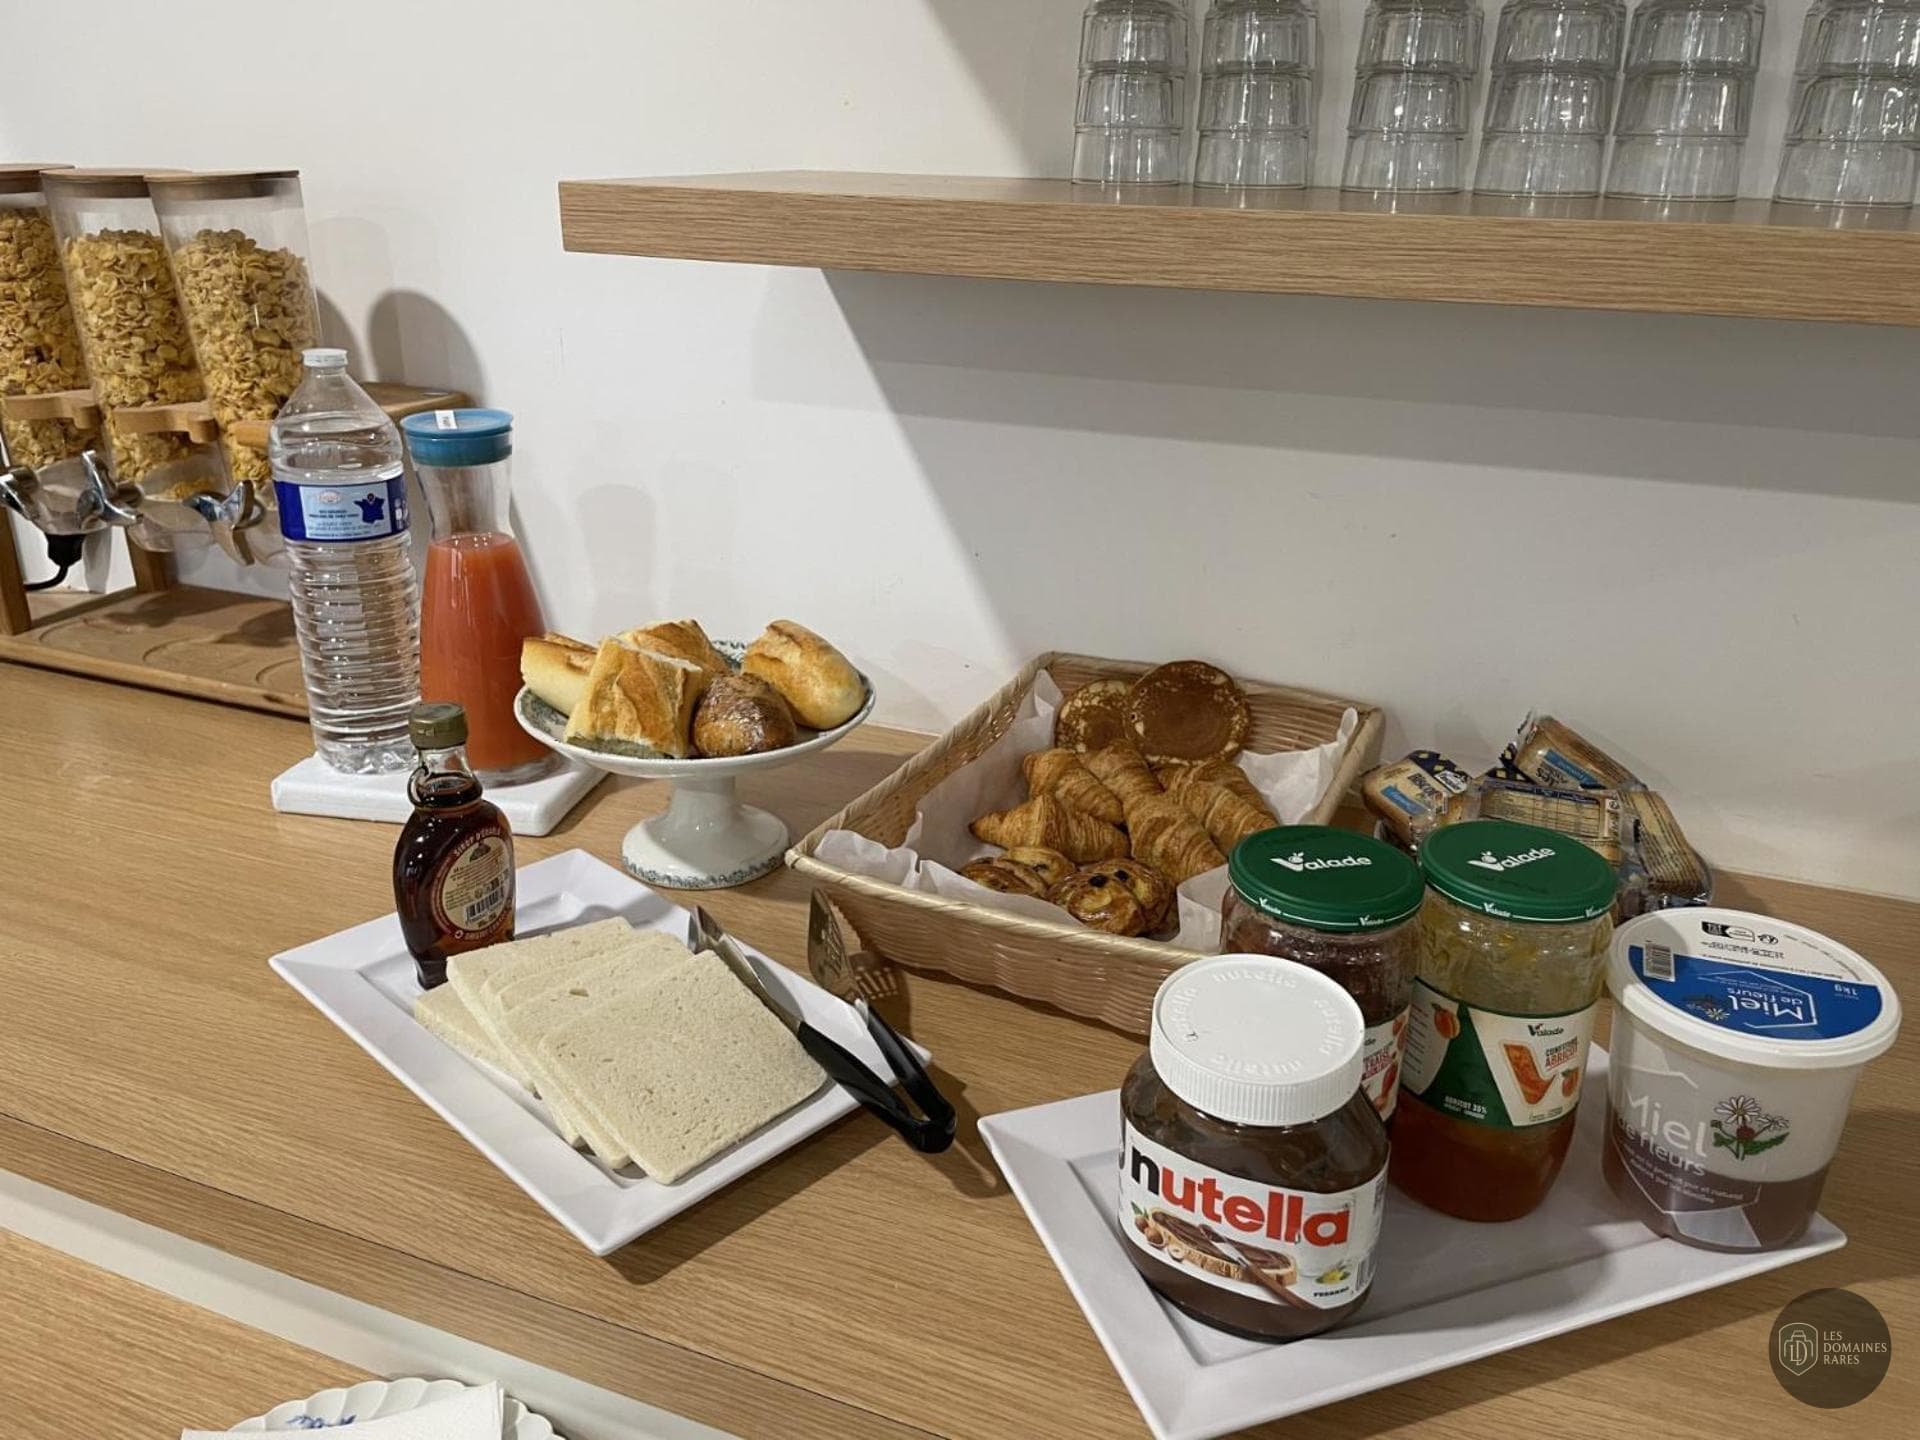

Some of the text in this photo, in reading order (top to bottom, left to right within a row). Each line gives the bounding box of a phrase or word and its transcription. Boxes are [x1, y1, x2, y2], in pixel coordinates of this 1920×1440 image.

[1270, 852, 1373, 872] Valade
[1467, 847, 1556, 872] Valade
[1727, 987, 1803, 1006] de fleurs
[1834, 985, 1858, 997] 1kg
[1728, 995, 1803, 1021] Miel
[1528, 1023, 1565, 1037] Valade
[1624, 1089, 1708, 1157] Miel
[1640, 1131, 1706, 1176] fleurs
[1131, 1145, 1350, 1248] nutella
